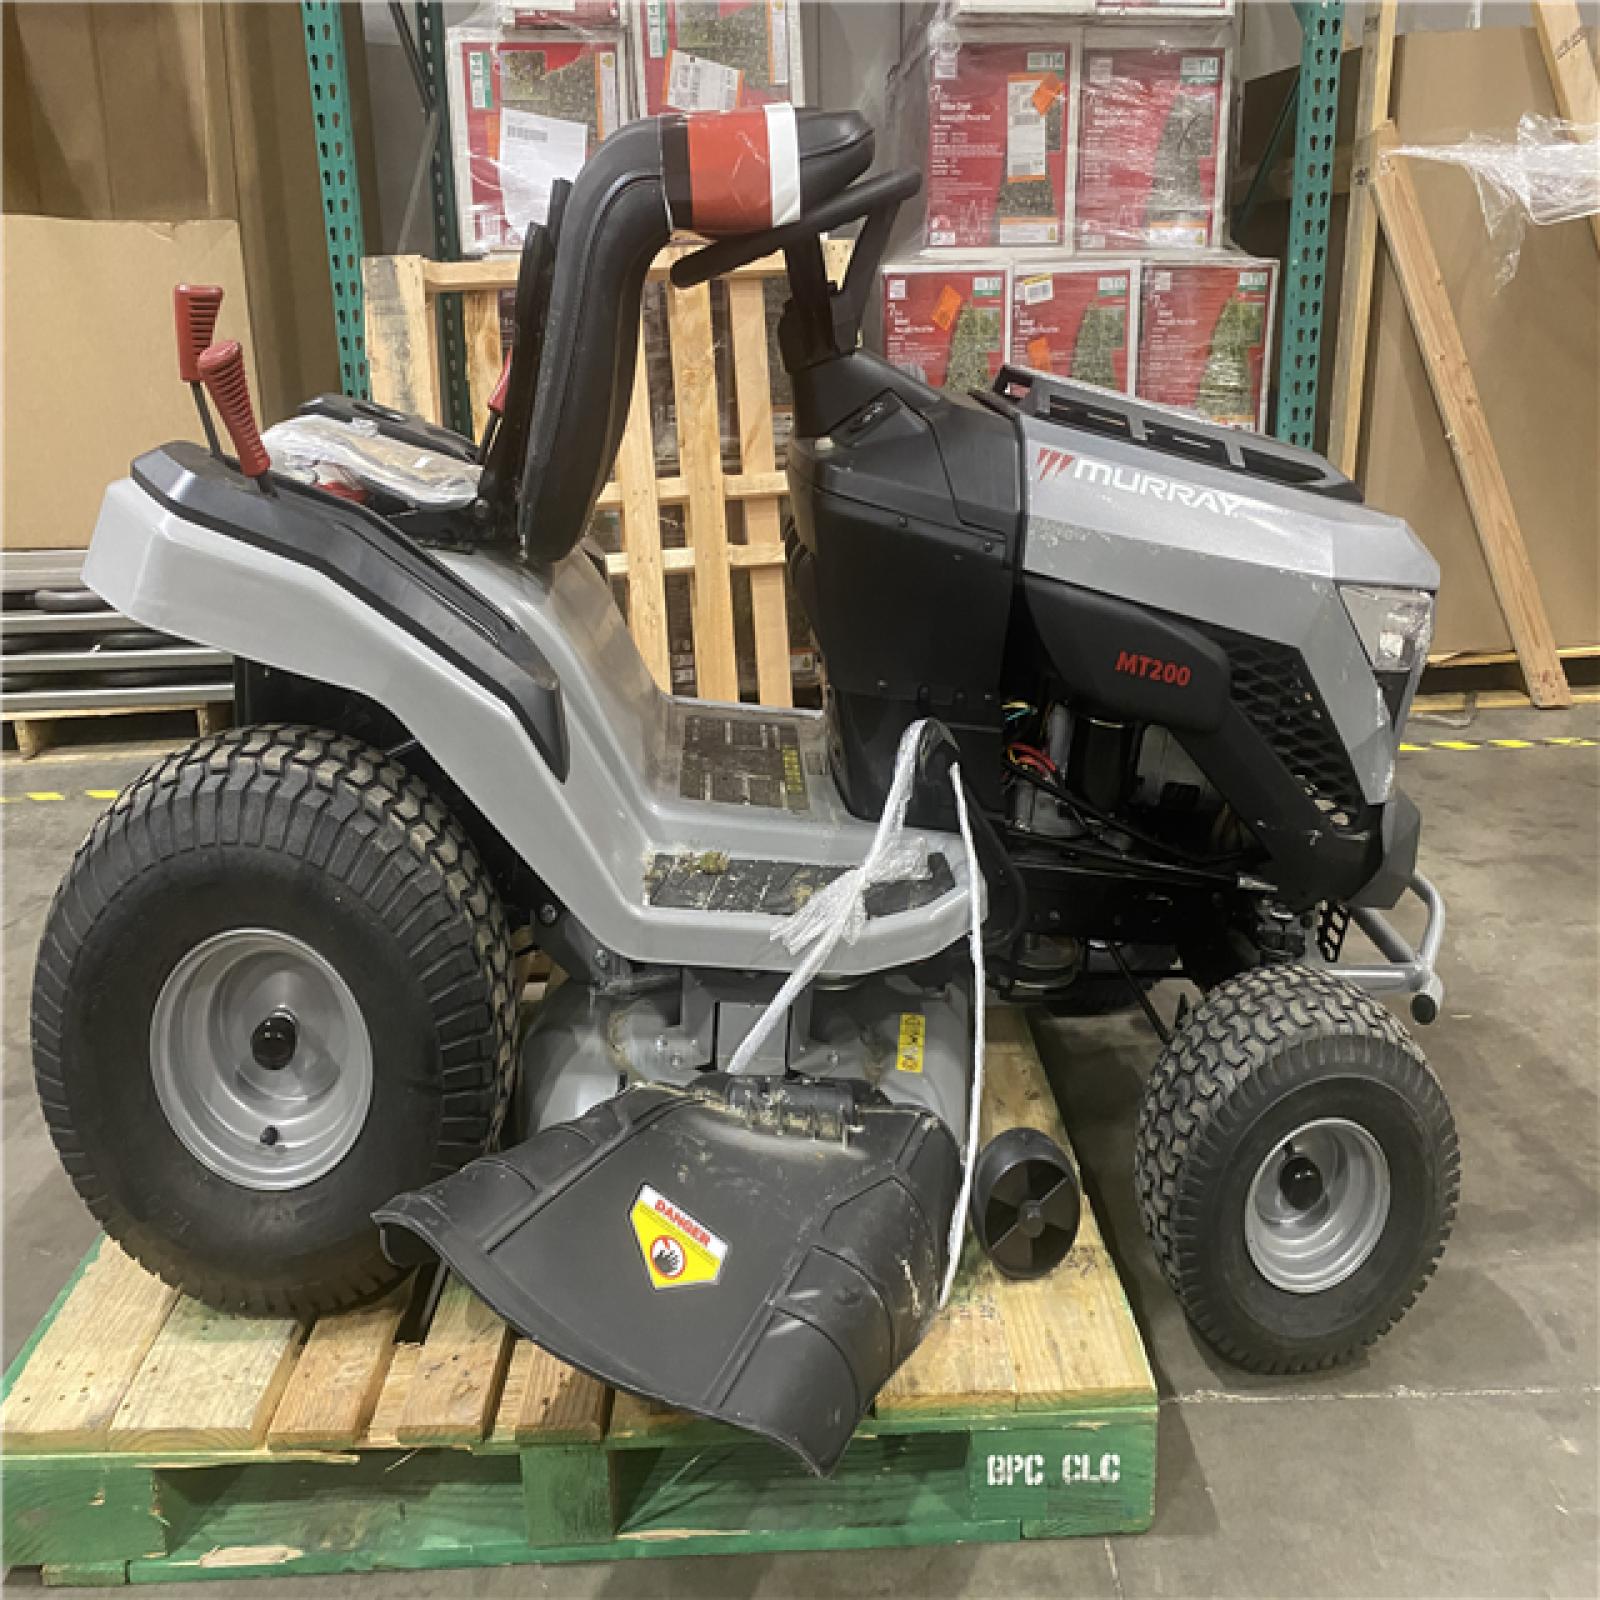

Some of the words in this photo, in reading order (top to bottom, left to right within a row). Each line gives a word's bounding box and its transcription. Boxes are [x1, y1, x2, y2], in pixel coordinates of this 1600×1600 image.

[1074, 459, 1241, 516] MURRAY
[1115, 651, 1192, 686] MT200
[654, 1199, 711, 1247] DANGER
[986, 1454, 1045, 1486] BPC
[1062, 1453, 1121, 1485] CLC
